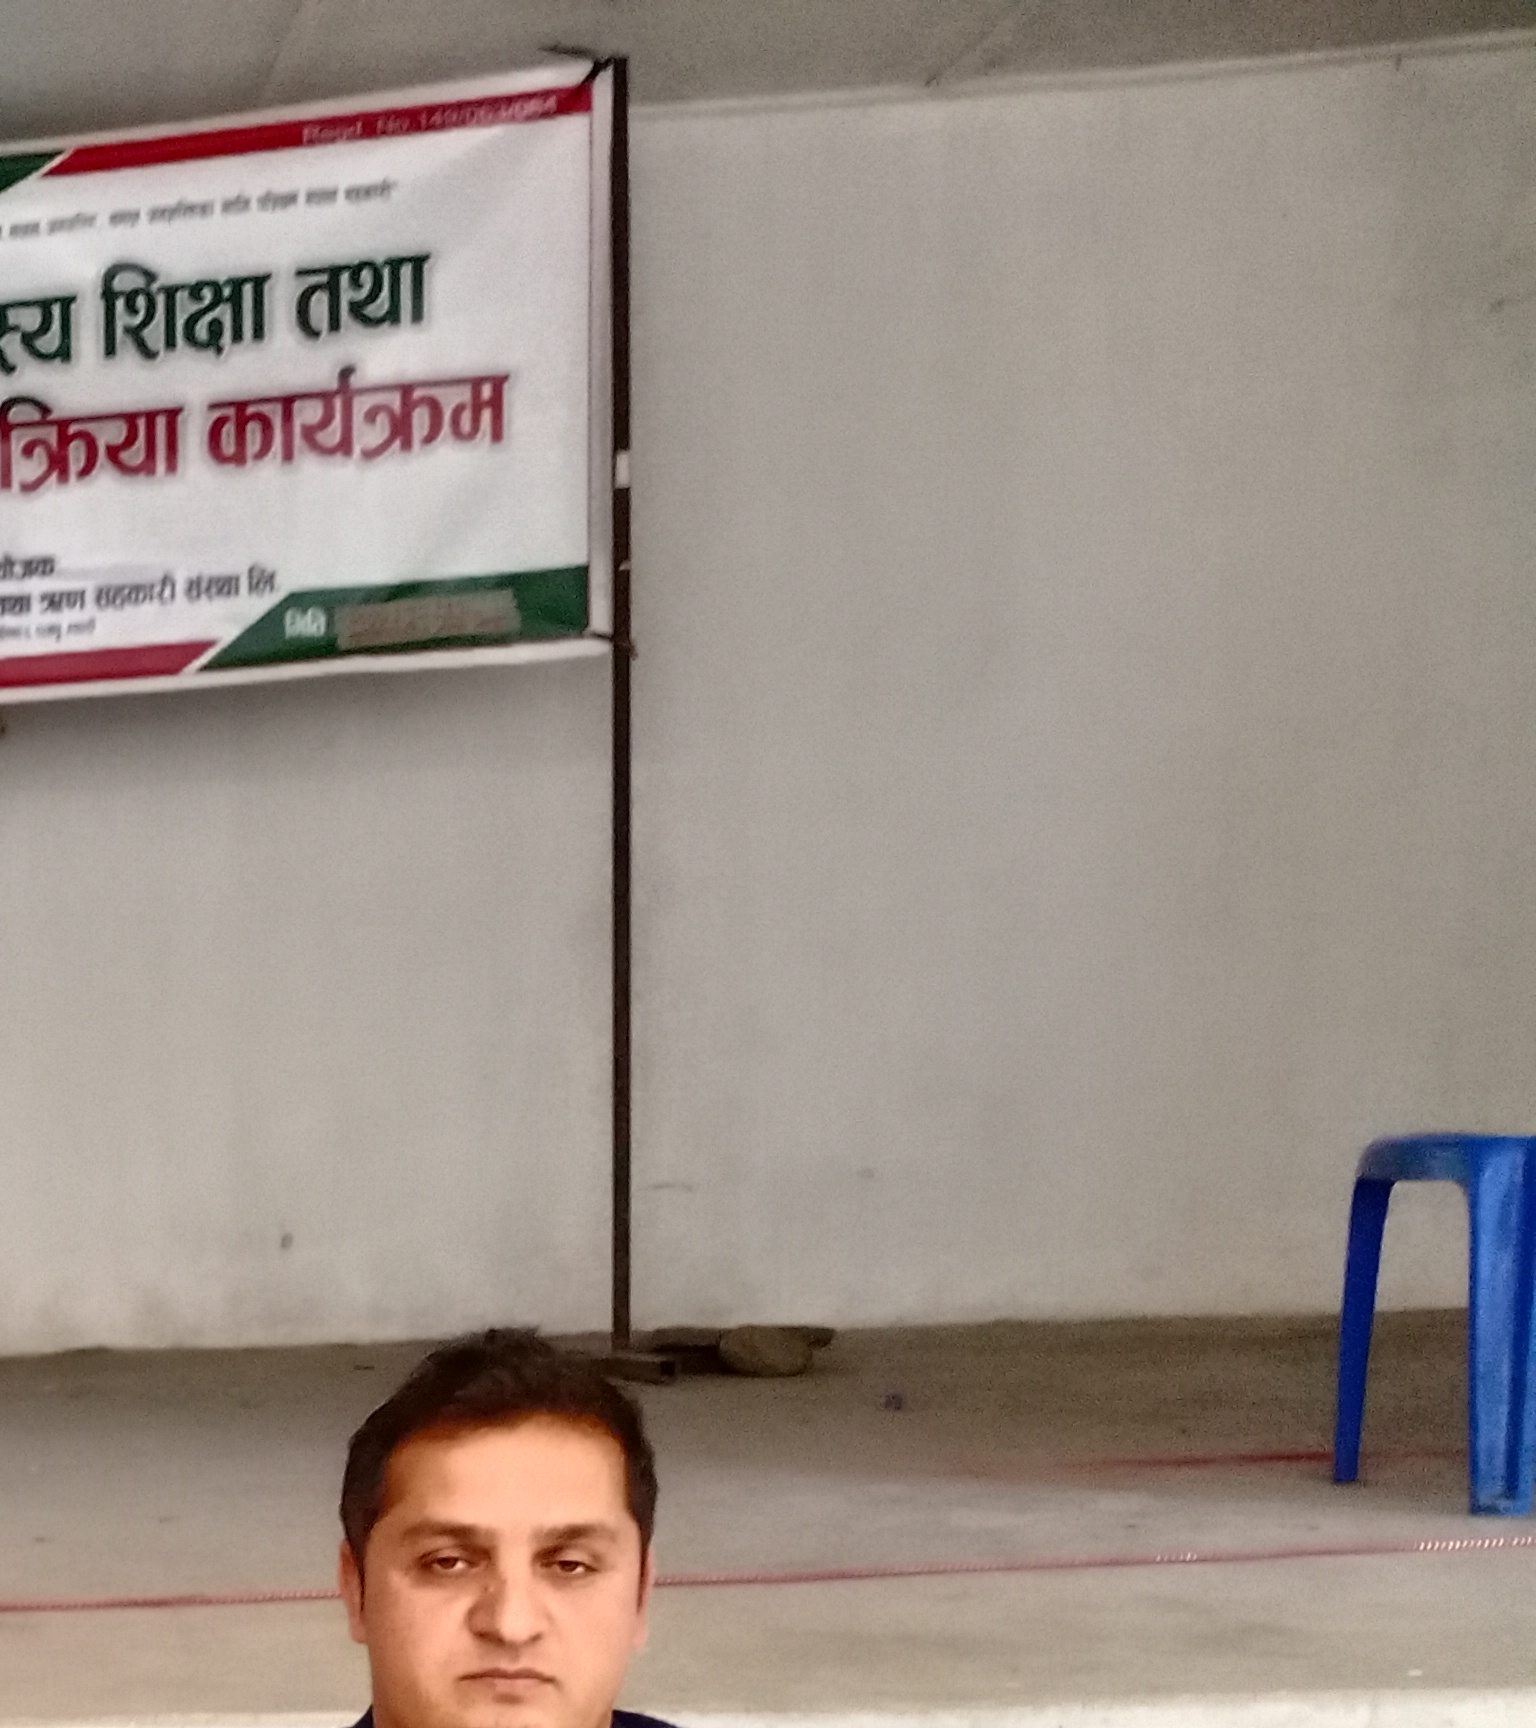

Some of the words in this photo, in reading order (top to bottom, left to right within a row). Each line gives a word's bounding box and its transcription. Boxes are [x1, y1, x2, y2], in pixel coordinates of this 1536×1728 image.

[99, 262, 273, 362] शिक्षा
[294, 252, 432, 341] तथा
[205, 364, 511, 468] कार्यक्रम
[93, 572, 177, 609] सहकारी
